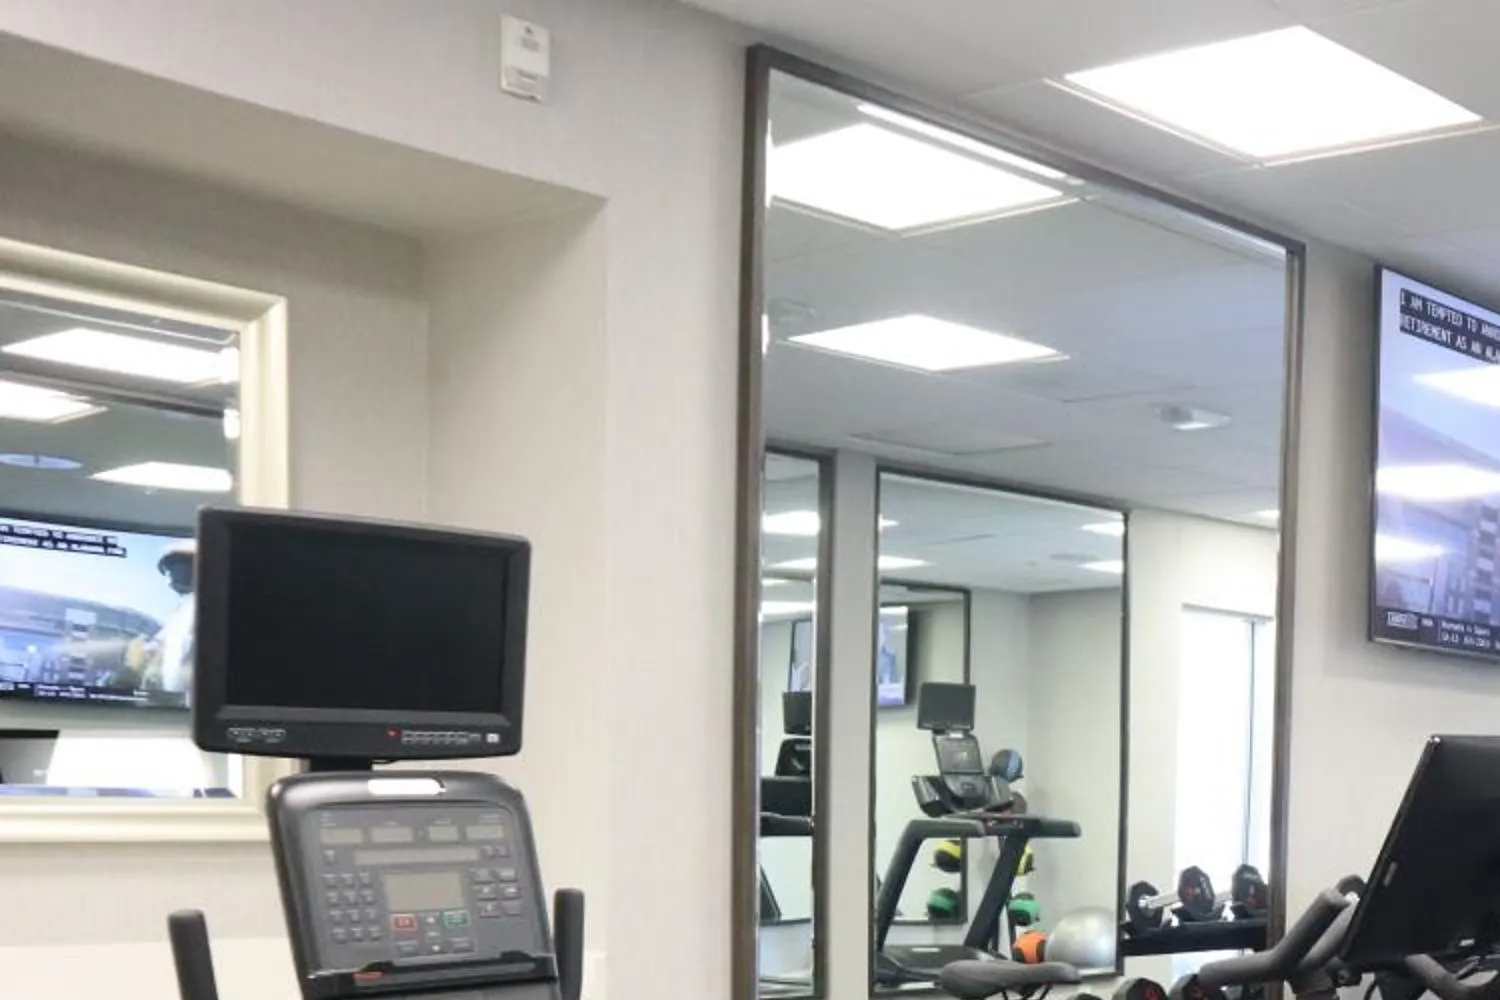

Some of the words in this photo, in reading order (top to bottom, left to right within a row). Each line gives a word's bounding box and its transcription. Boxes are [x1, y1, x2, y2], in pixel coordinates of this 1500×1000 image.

[1427, 301, 1463, 326] TEMPTED
[1467, 317, 1479, 333] TO
[1455, 335, 1467, 350] AS
